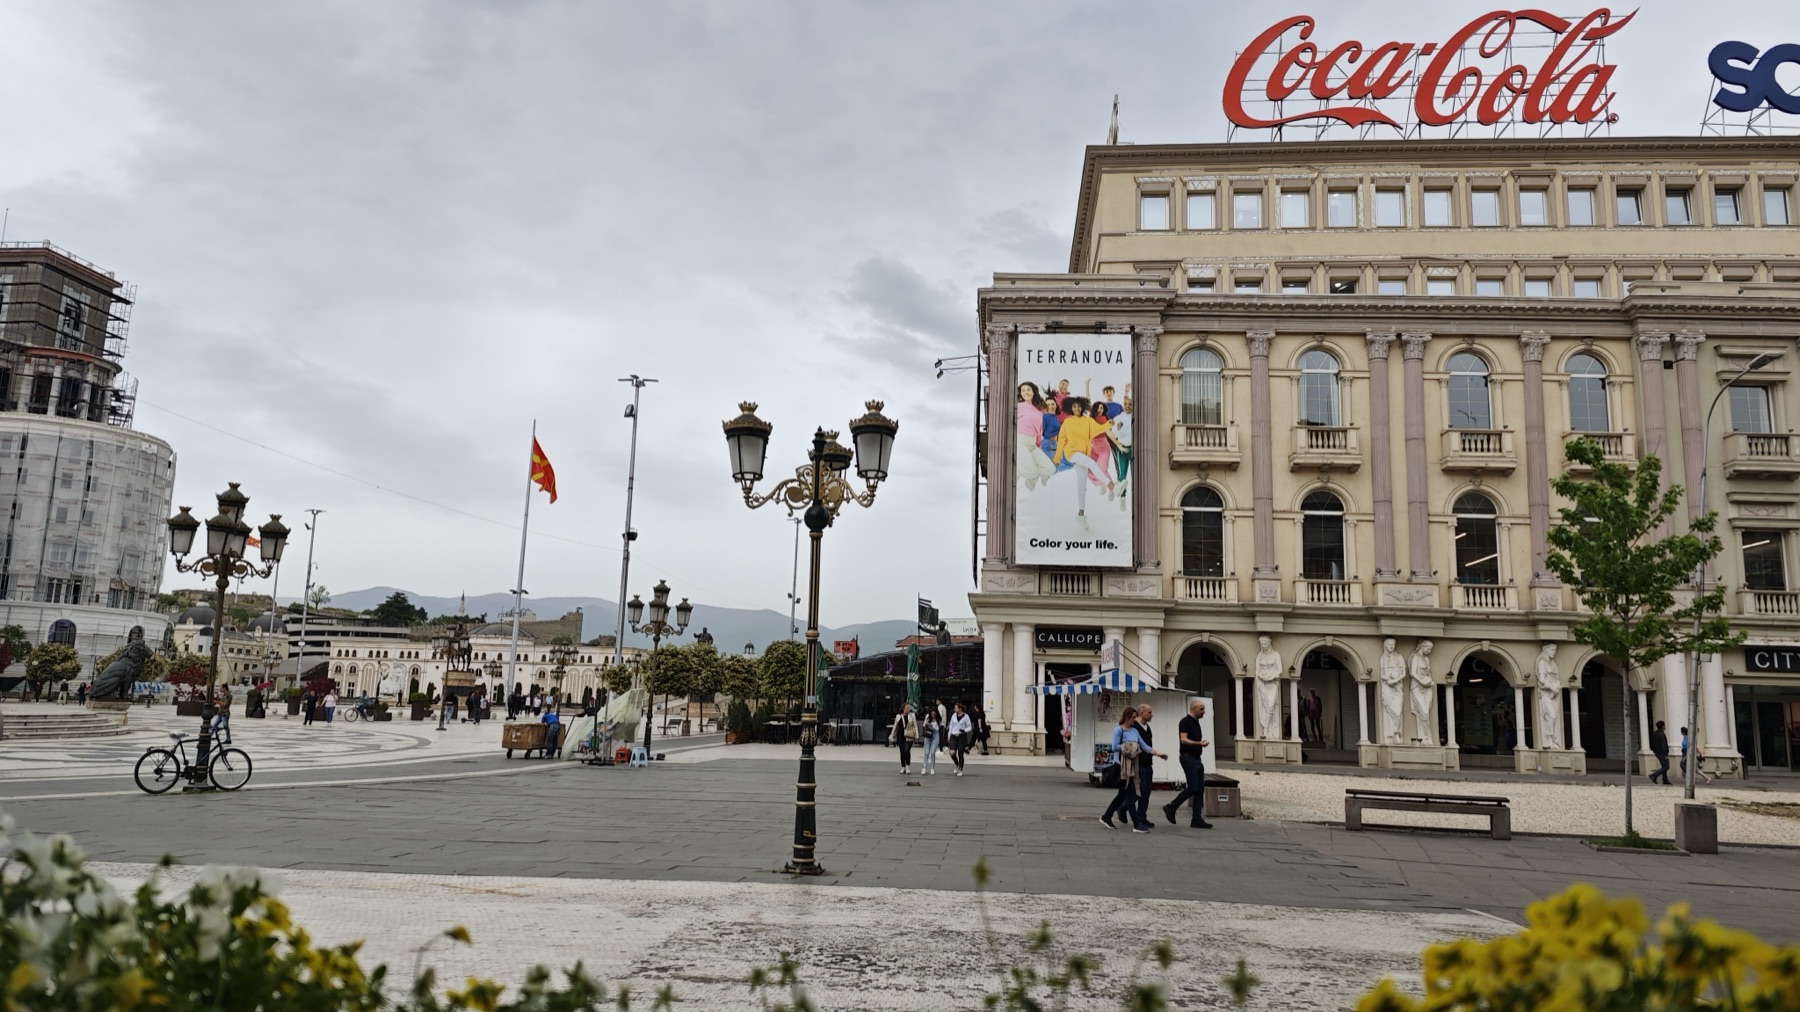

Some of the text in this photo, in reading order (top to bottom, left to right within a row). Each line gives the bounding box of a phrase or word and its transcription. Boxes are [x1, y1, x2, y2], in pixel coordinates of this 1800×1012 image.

[1222, 6, 1641, 128] Coca-Cola
[1026, 349, 1123, 364] TERRANOVA
[1029, 538, 1118, 551] Color your life.
[1038, 633, 1101, 644] CALLIOPE
[1754, 651, 1800, 669] CIT
